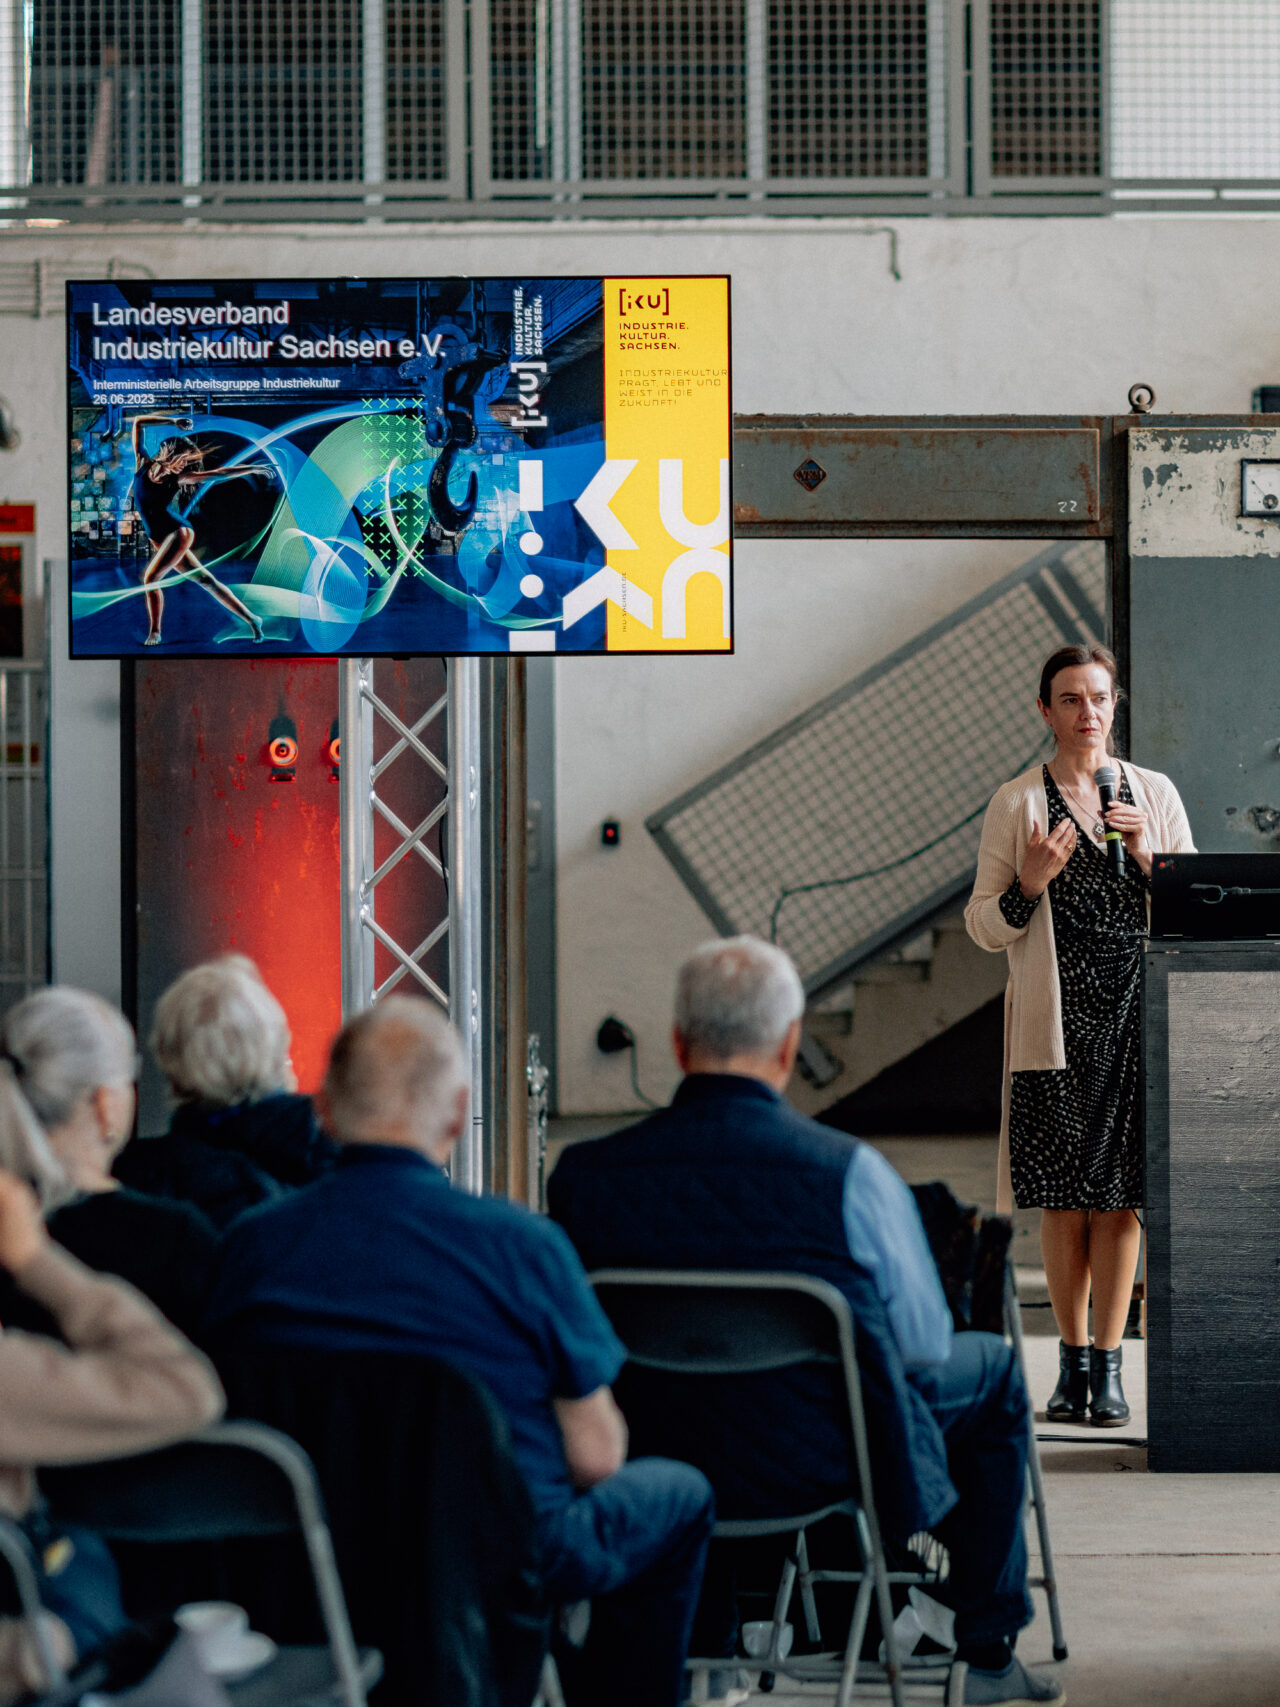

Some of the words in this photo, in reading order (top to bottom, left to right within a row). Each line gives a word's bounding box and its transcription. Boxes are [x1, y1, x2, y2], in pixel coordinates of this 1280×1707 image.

[92, 301, 290, 326] Landesverband
[619, 322, 689, 330] INDUSTRIE.
[619, 332, 670, 340] KULTUR.
[93, 335, 274, 360] Industriekultur
[279, 334, 391, 359] Sachsen
[398, 333, 446, 357] e.V.
[619, 342, 680, 350] SACHSEN.
[93, 378, 181, 390] Interministerielle
[184, 378, 260, 392] Arbeitsgruppe
[263, 377, 341, 389] Industriekultur
[93, 393, 155, 405] 26.06.2023
